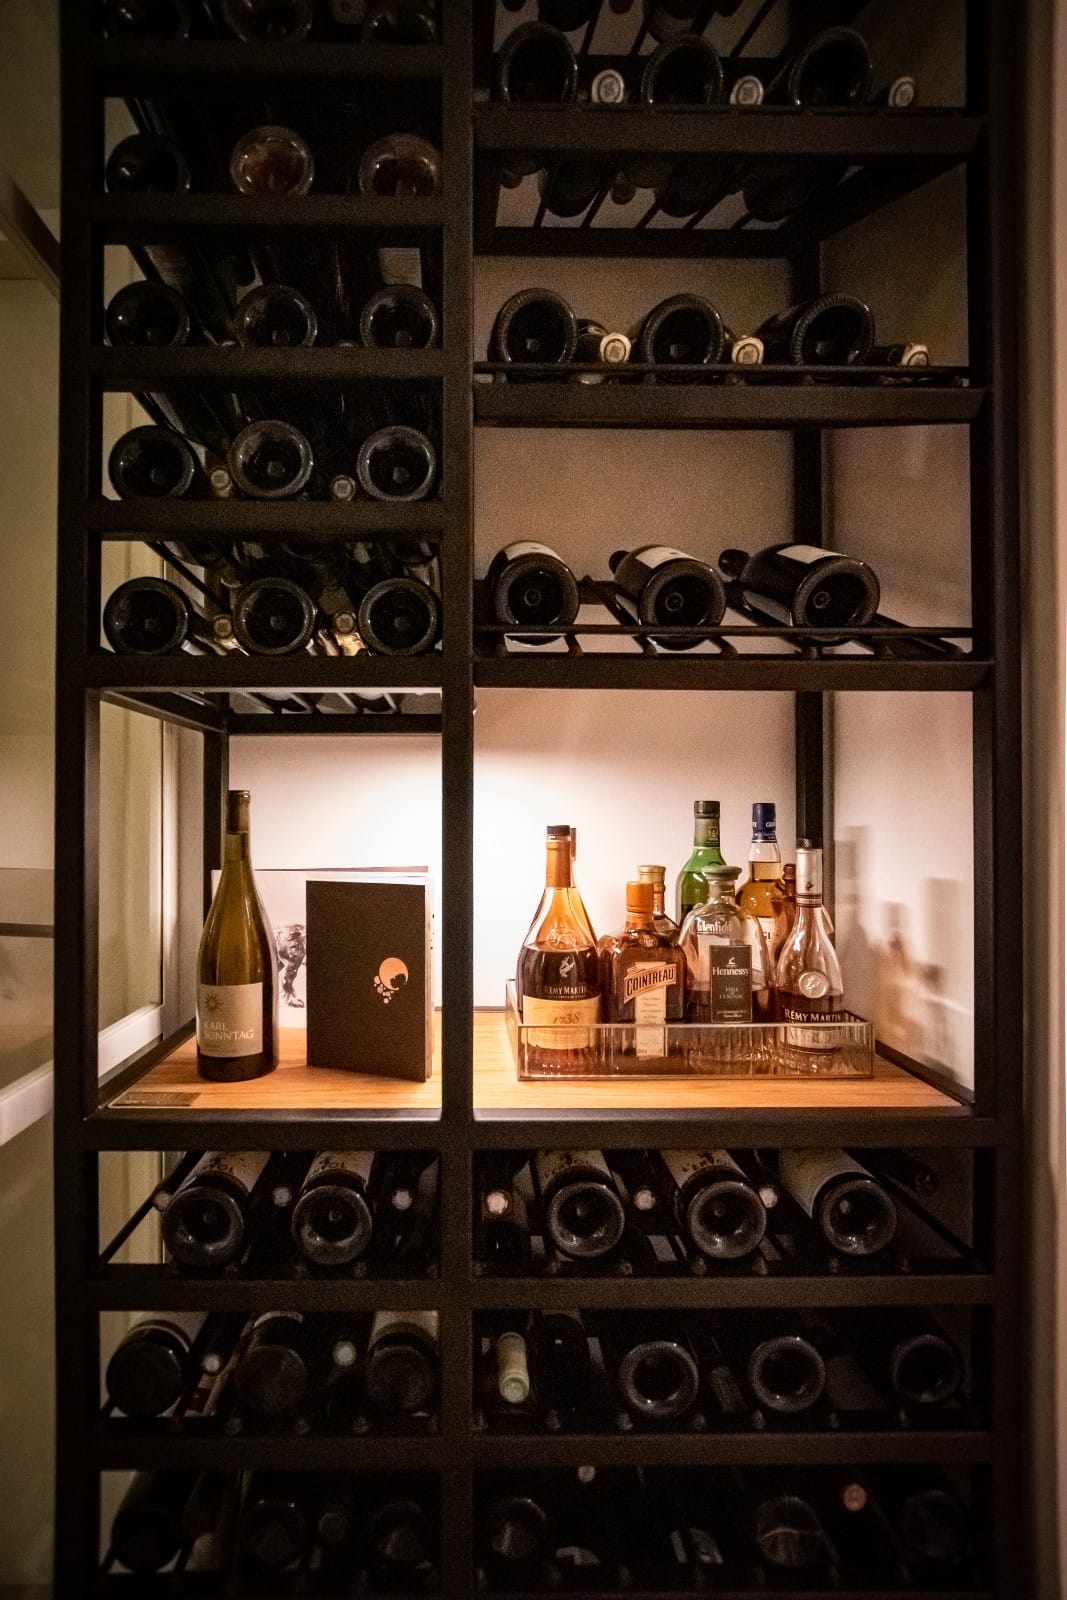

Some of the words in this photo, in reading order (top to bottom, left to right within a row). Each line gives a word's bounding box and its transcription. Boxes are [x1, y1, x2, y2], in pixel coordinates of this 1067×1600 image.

[712, 966, 749, 976] Hennessy
[626, 968, 675, 997] COINTREAU
[784, 1007, 808, 1021] RÉMY
[810, 1011, 842, 1022] MARTIN
[203, 1028, 255, 1041] SONNTAG
